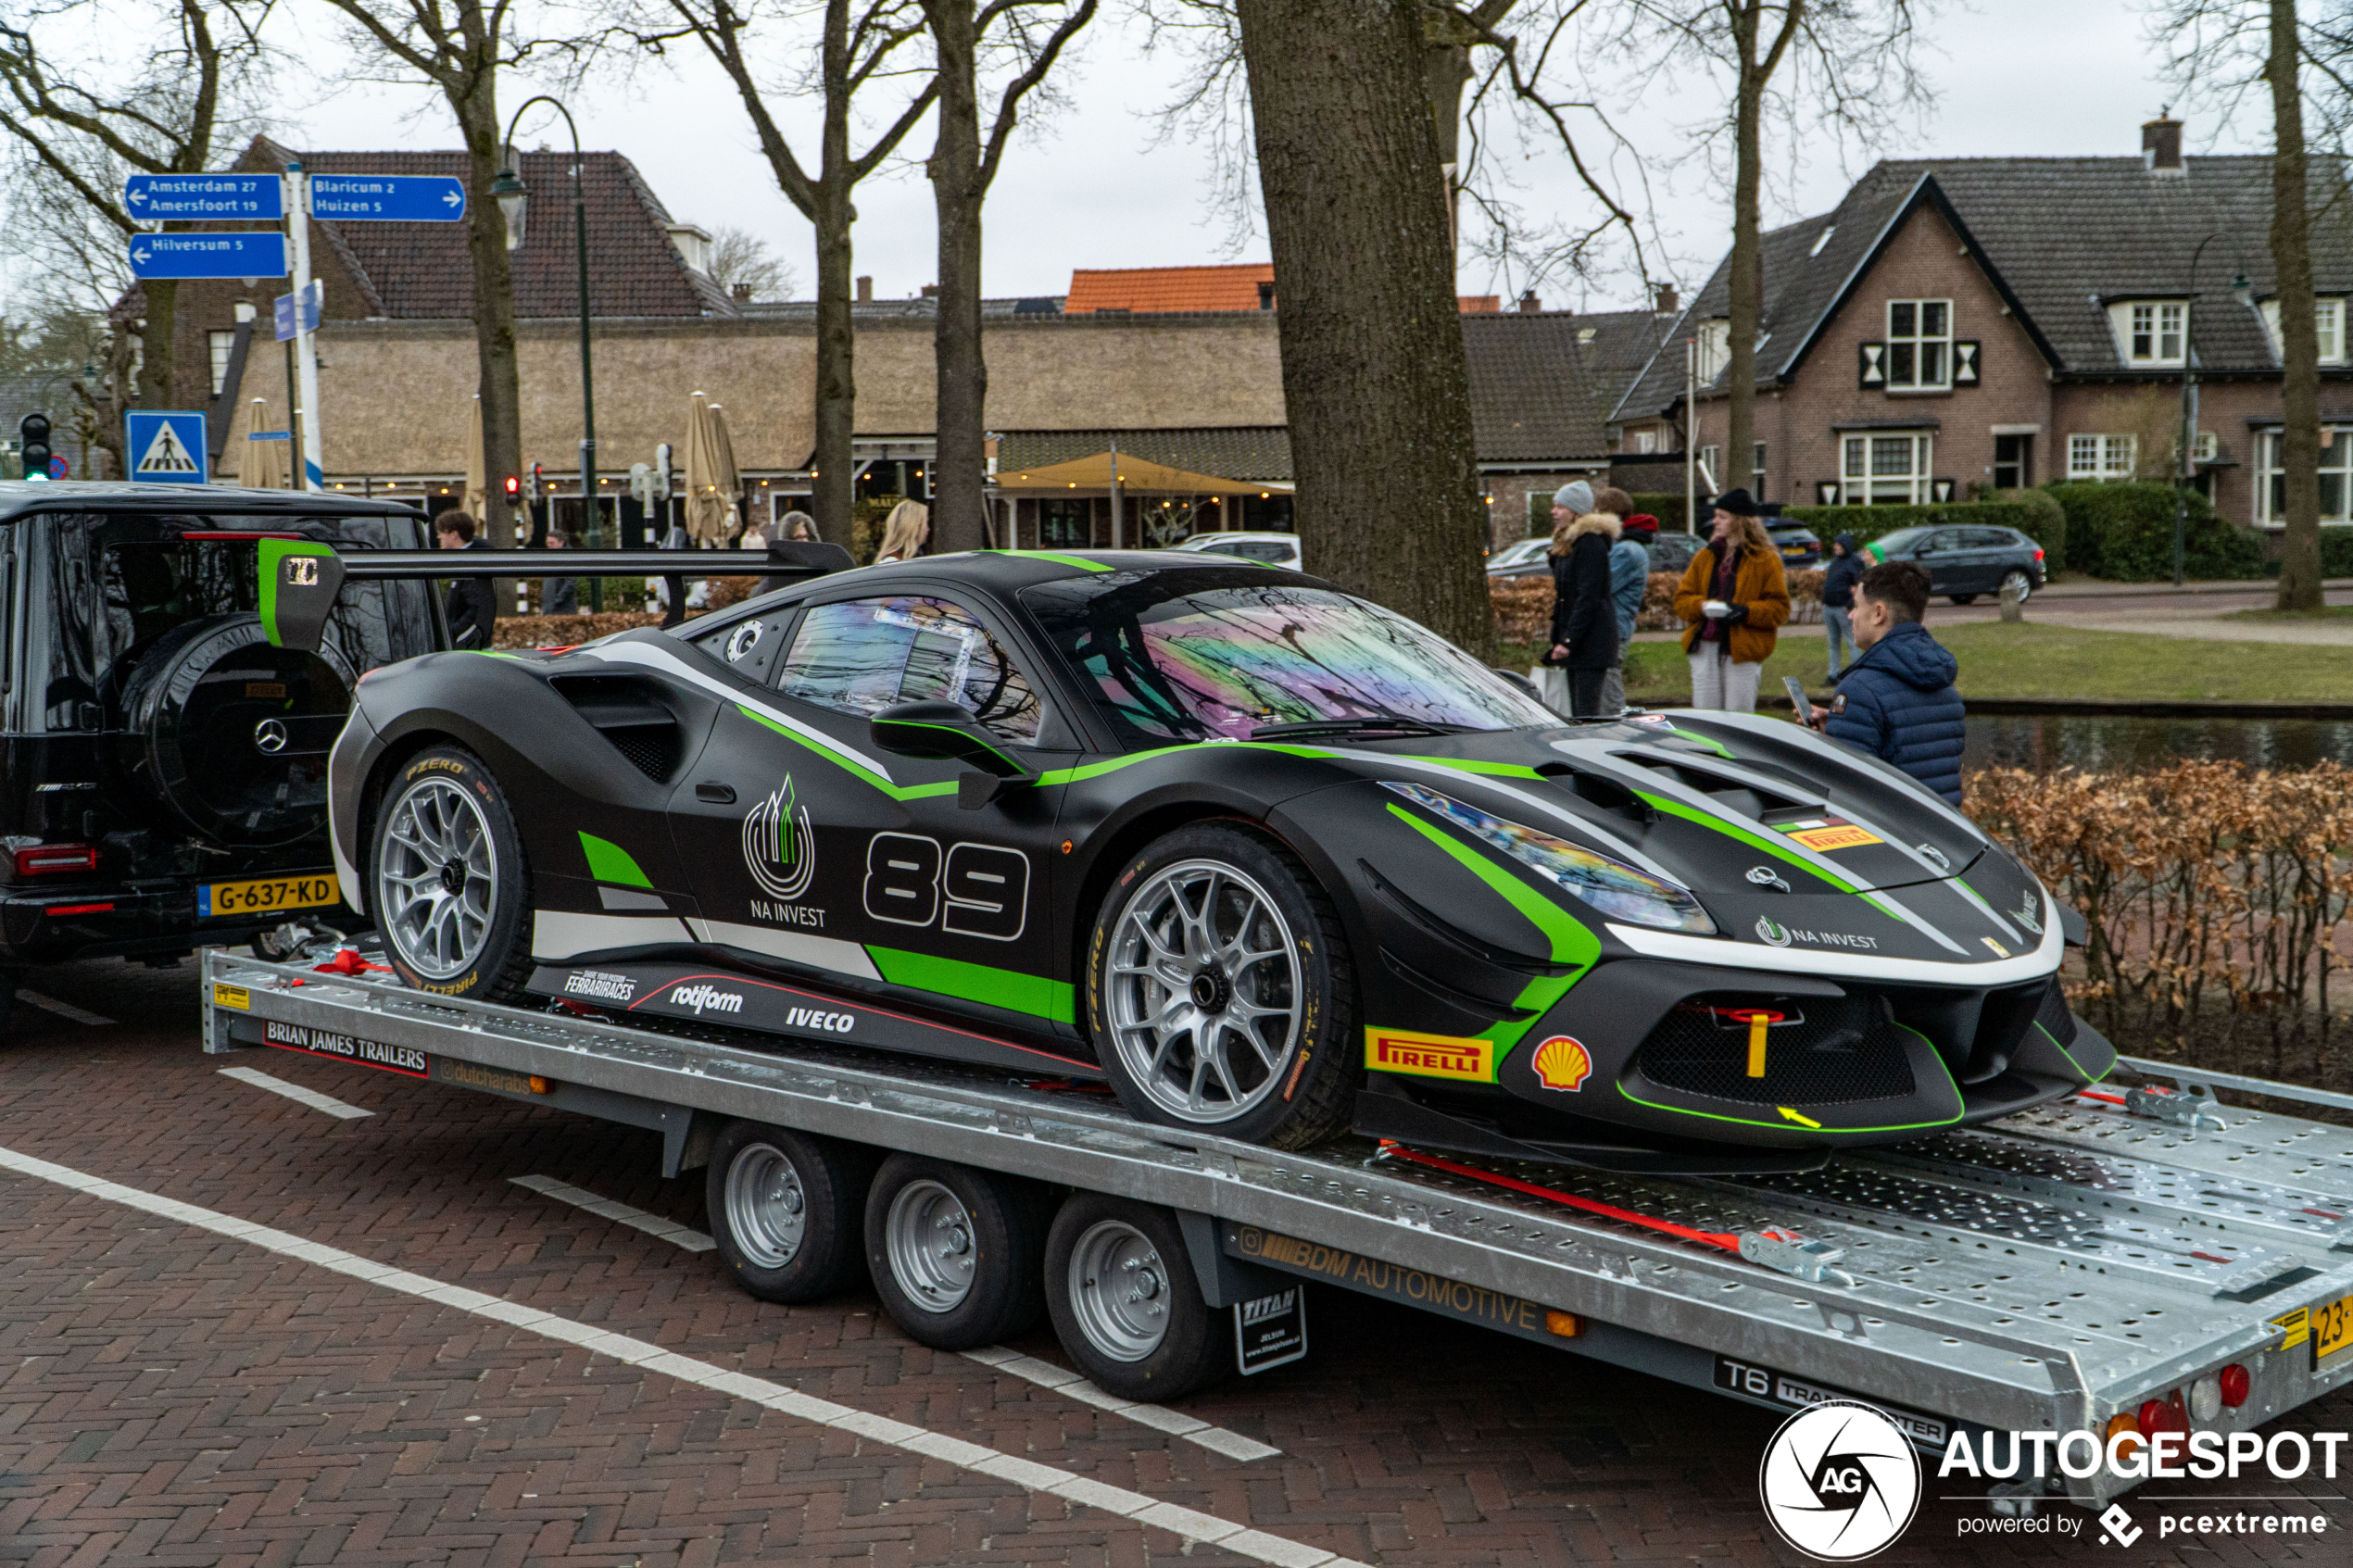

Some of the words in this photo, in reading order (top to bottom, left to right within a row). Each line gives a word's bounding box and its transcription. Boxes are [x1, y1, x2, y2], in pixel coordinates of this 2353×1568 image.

[148, 180, 237, 193] Amsterdam
[241, 182, 258, 193] 27
[315, 181, 383, 194] Blaricum
[386, 183, 396, 194] 2
[149, 198, 238, 211] Amersfoort
[243, 200, 258, 211] 19
[316, 199, 370, 212] Huizen
[374, 201, 383, 212] 5
[152, 239, 231, 251] Hilversum
[235, 240, 244, 251] 5
[1800, 829, 1872, 847] PIRELLI
[220, 879, 330, 909] G-637-KD
[863, 831, 1030, 942] 89
[750, 899, 773, 920] NA
[774, 903, 825, 927] INVEST
[1791, 929, 1819, 943] NA
[1819, 932, 1878, 949] INVEST
[564, 975, 635, 1001] FERRARIRACES
[670, 985, 743, 1014] rotiform
[786, 1007, 855, 1033] IVECO
[268, 1021, 308, 1046] BRIAN
[309, 1030, 355, 1056] JAMES
[358, 1040, 426, 1071] TRAILERS
[1378, 1037, 1481, 1073] PIRELLI
[1293, 1242, 1352, 1277] BDM
[1353, 1257, 1537, 1332] AUTOMOTIVE
[1243, 1288, 1296, 1321] TITAN
[1723, 1360, 1769, 1396] T6
